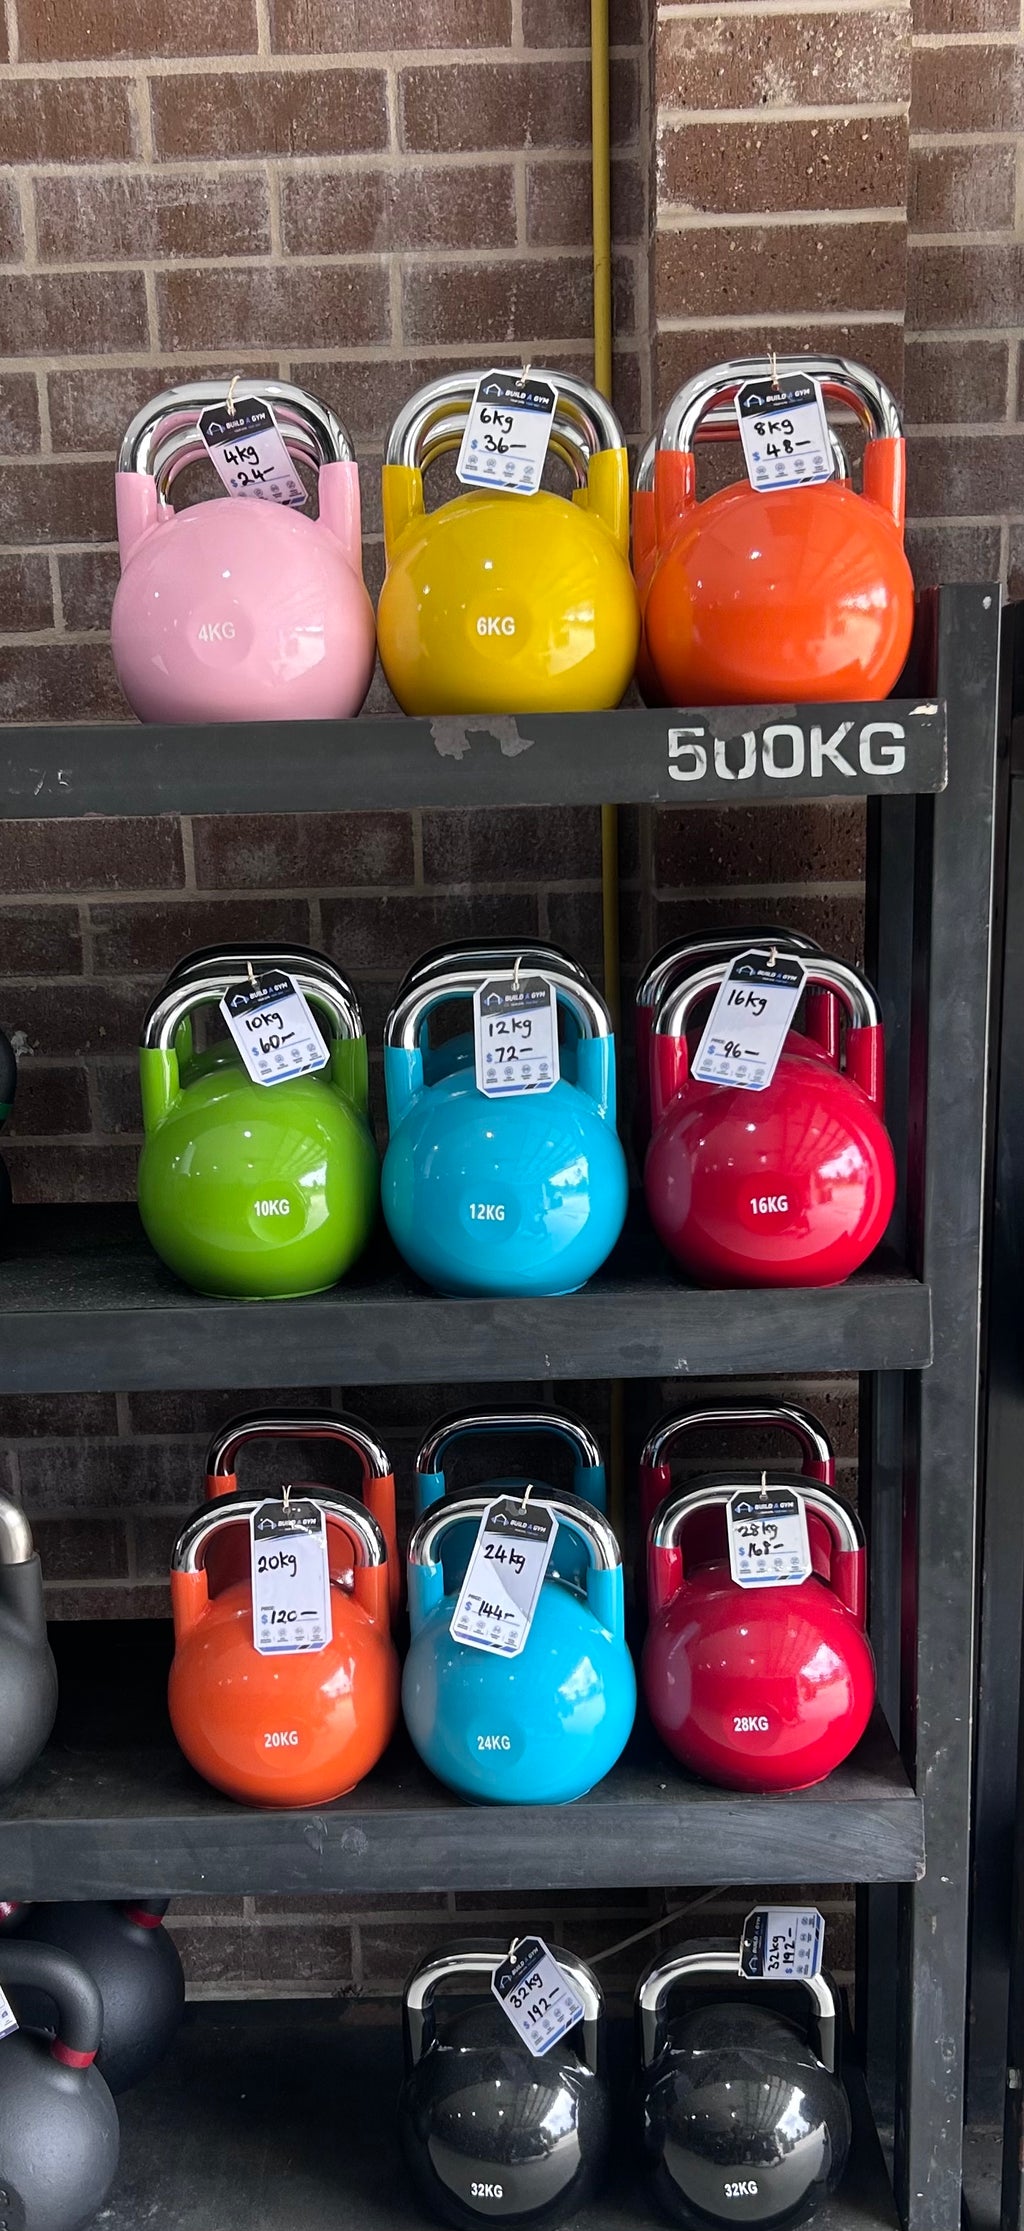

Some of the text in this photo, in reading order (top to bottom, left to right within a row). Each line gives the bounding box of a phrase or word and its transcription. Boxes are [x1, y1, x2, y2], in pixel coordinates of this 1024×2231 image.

[505, 390, 526, 399] BUILD
[534, 395, 550, 404] GYM
[766, 393, 786, 402] BUILD
[794, 388, 810, 397] GYM
[226, 419, 244, 430] BUILD
[251, 413, 266, 422] GYM
[480, 408, 514, 434] 6kg
[754, 419, 794, 436] 8kg
[223, 445, 260, 466] 4kg
[198, 621, 236, 642] 4KG
[476, 616, 516, 636] 6KG
[668, 722, 906, 781] 500KG
[757, 970, 776, 978] BUILD
[250, 988, 268, 1000] BUILD
[274, 982, 288, 991] GYM
[505, 994, 524, 1002] BUILD
[531, 991, 546, 999] GYM
[727, 989, 768, 1016] 16kg
[246, 1012, 284, 1032] 10kg
[488, 1018, 532, 1039] 12kg
[254, 1198, 290, 1216] 10KG
[470, 1203, 505, 1221] 12KG
[750, 1195, 788, 1214] 16KG
[510, 1519, 527, 1528] BUILD
[258, 1551, 298, 1578] 20kg
[484, 1544, 526, 1574] 24kg
[734, 1716, 769, 1732] 28KG
[264, 1730, 298, 1748] 20KG
[477, 1735, 511, 1750] 24KG
[768, 1936, 786, 1972] 32kg
[510, 1972, 544, 2009] 32kg
[470, 2182, 503, 2198] 32KG
[724, 2180, 758, 2198] 32KG
